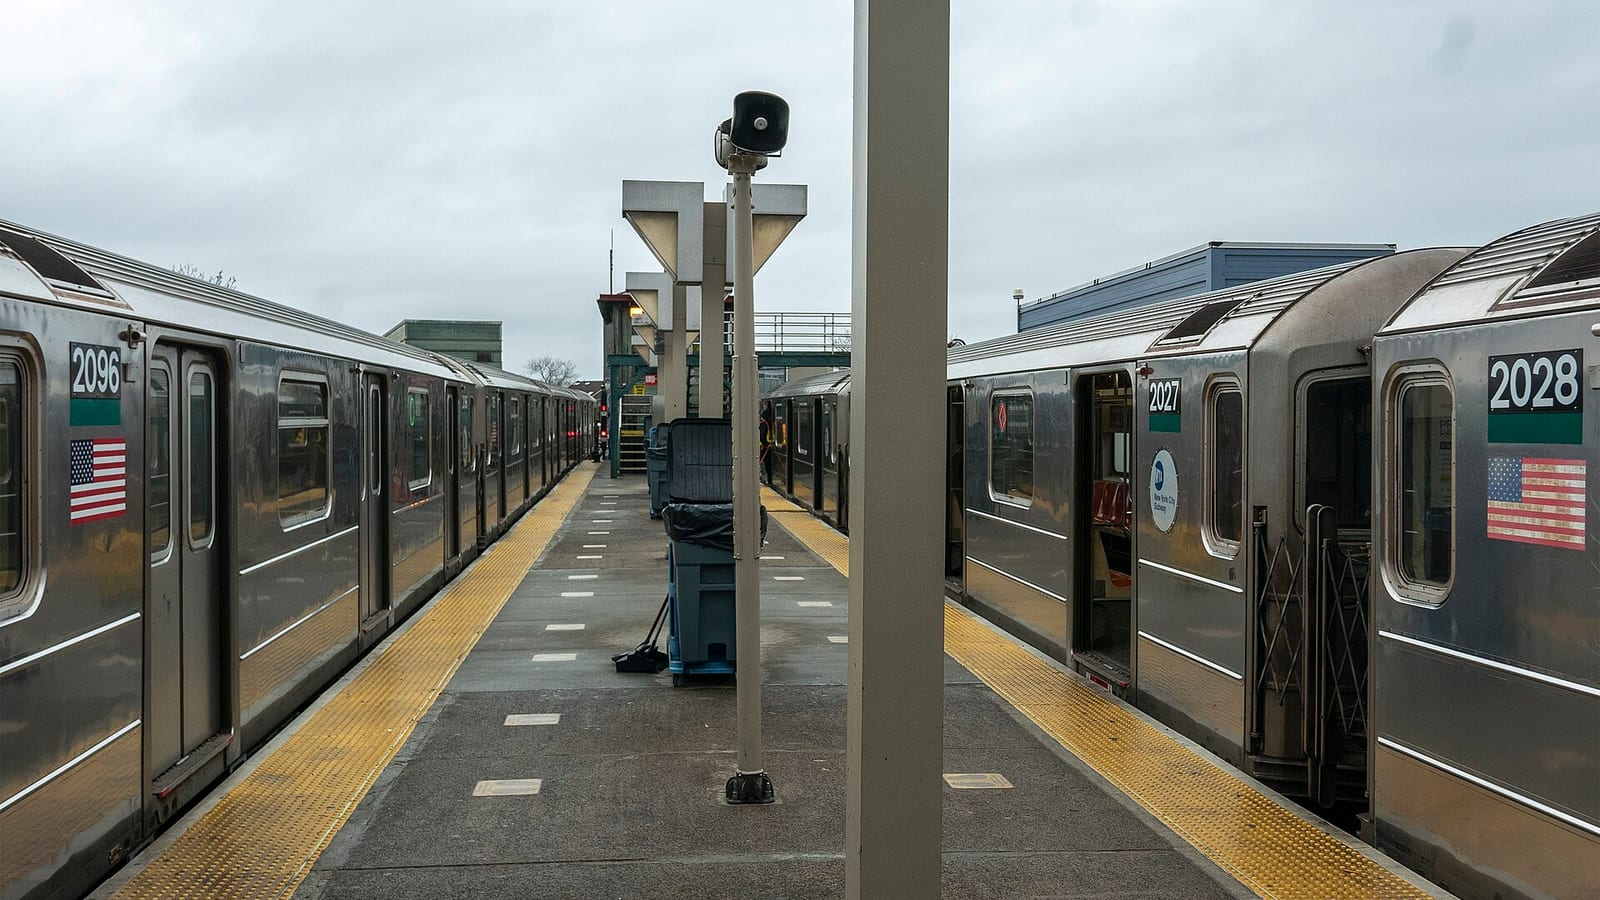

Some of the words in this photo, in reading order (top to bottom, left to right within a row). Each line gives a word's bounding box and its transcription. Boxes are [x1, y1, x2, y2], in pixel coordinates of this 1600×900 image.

[73, 347, 120, 393] 2096
[1490, 354, 1579, 408] 2028
[1150, 380, 1180, 411] 2027
